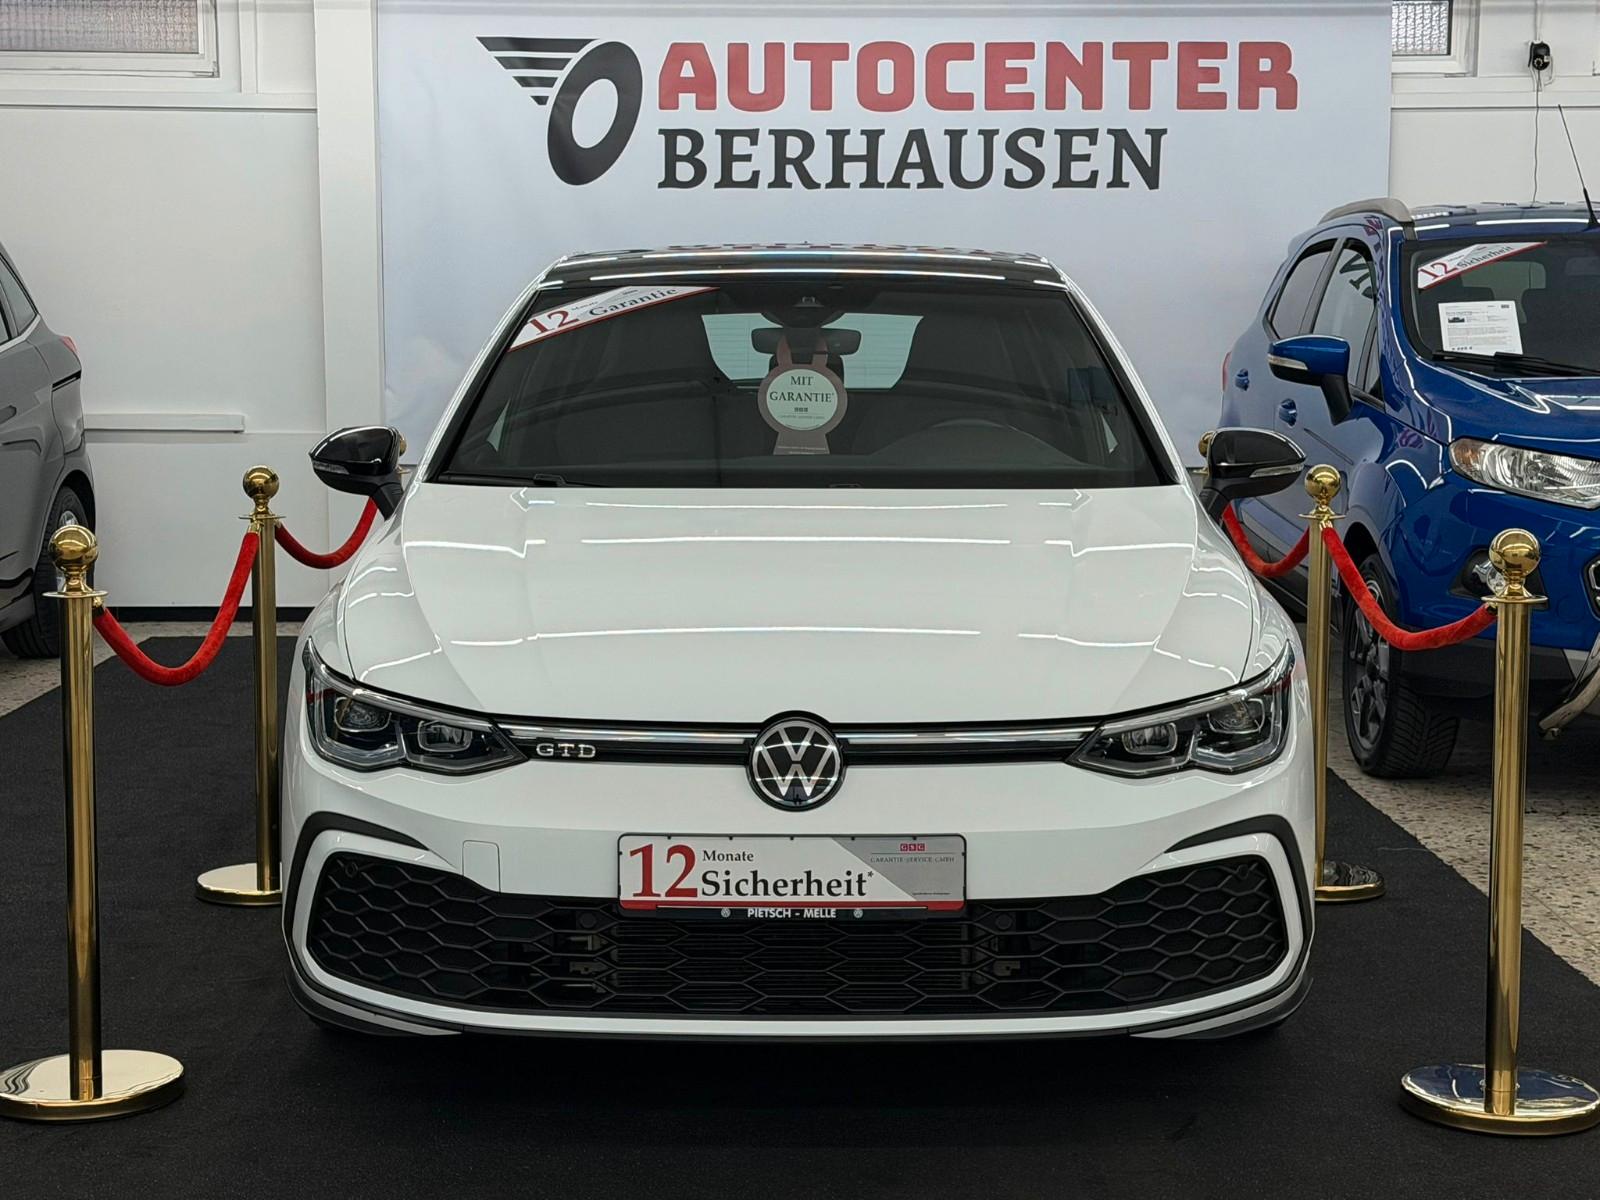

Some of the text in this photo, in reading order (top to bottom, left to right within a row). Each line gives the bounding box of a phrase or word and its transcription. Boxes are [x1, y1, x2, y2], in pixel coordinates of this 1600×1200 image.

[658, 41, 1298, 111] AUTOCENTER
[528, 288, 677, 336] 12 Garantie
[790, 375, 814, 386] MIT
[535, 743, 597, 758] GTD
[629, 843, 754, 899] 12 Monate
[747, 908, 792, 918] PIETSCH
[803, 908, 837, 918] MELLE
